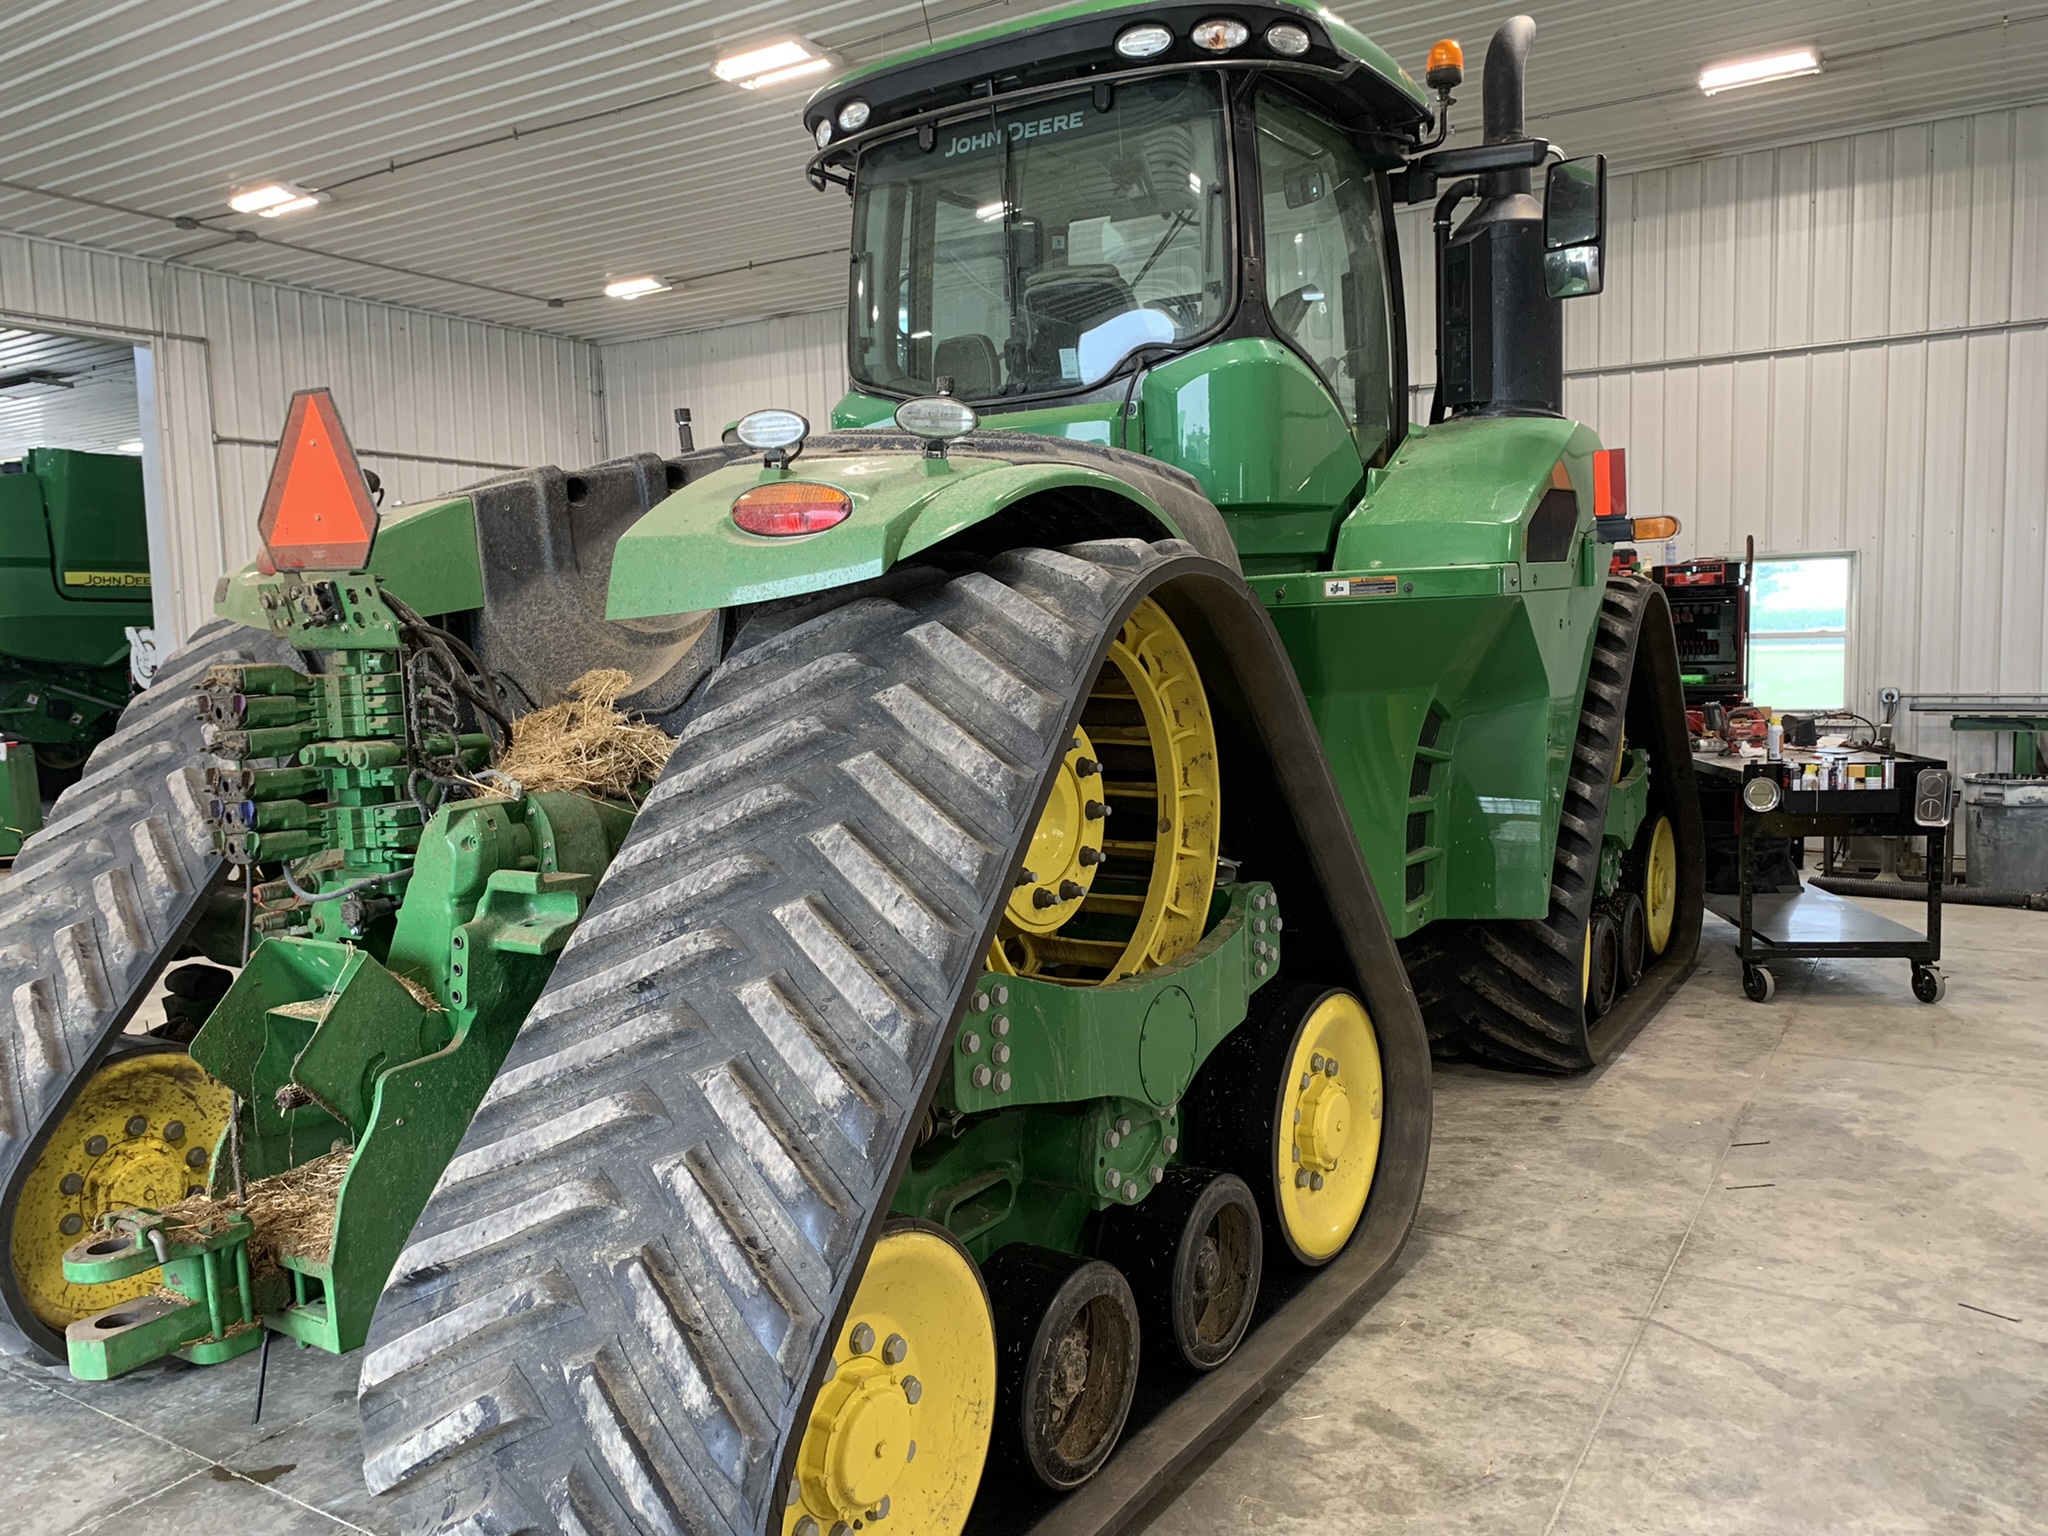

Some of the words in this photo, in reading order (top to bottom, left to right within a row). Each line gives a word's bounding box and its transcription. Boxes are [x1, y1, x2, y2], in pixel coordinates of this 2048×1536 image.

[945, 129, 1001, 157] JOHN
[1008, 111, 1084, 142] DEERE
[84, 574, 121, 585] JOHN
[124, 574, 150, 585] DEE
